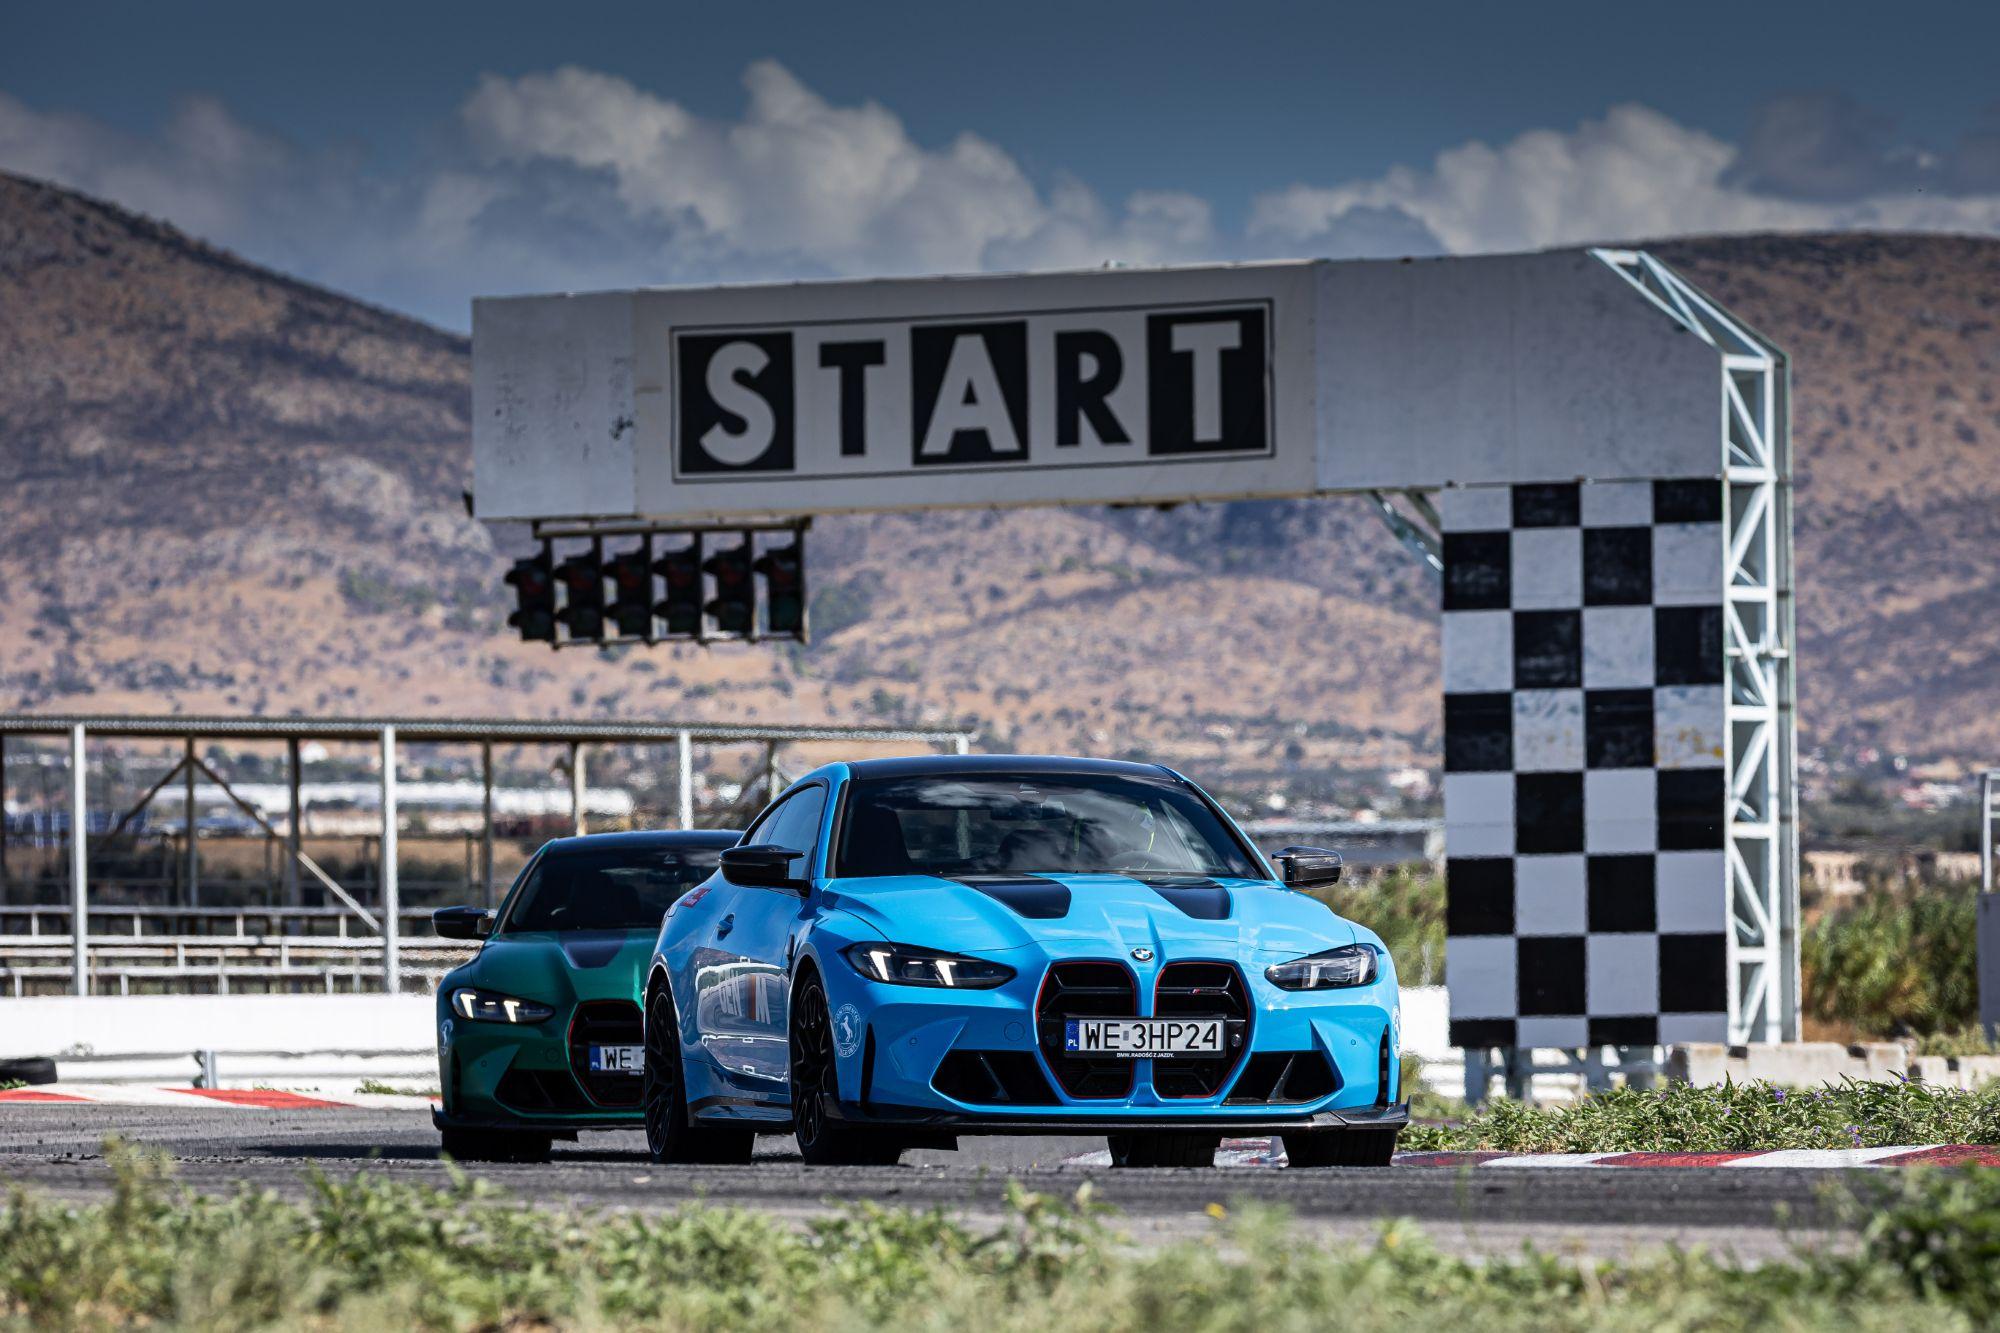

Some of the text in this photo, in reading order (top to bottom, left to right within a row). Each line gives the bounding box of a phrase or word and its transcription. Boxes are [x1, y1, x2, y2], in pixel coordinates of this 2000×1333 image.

[700, 320, 1242, 466] START
[1067, 1039, 1078, 1047] PL
[1084, 1022, 1218, 1050] WE 3HP24
[604, 1048, 632, 1069] WE
